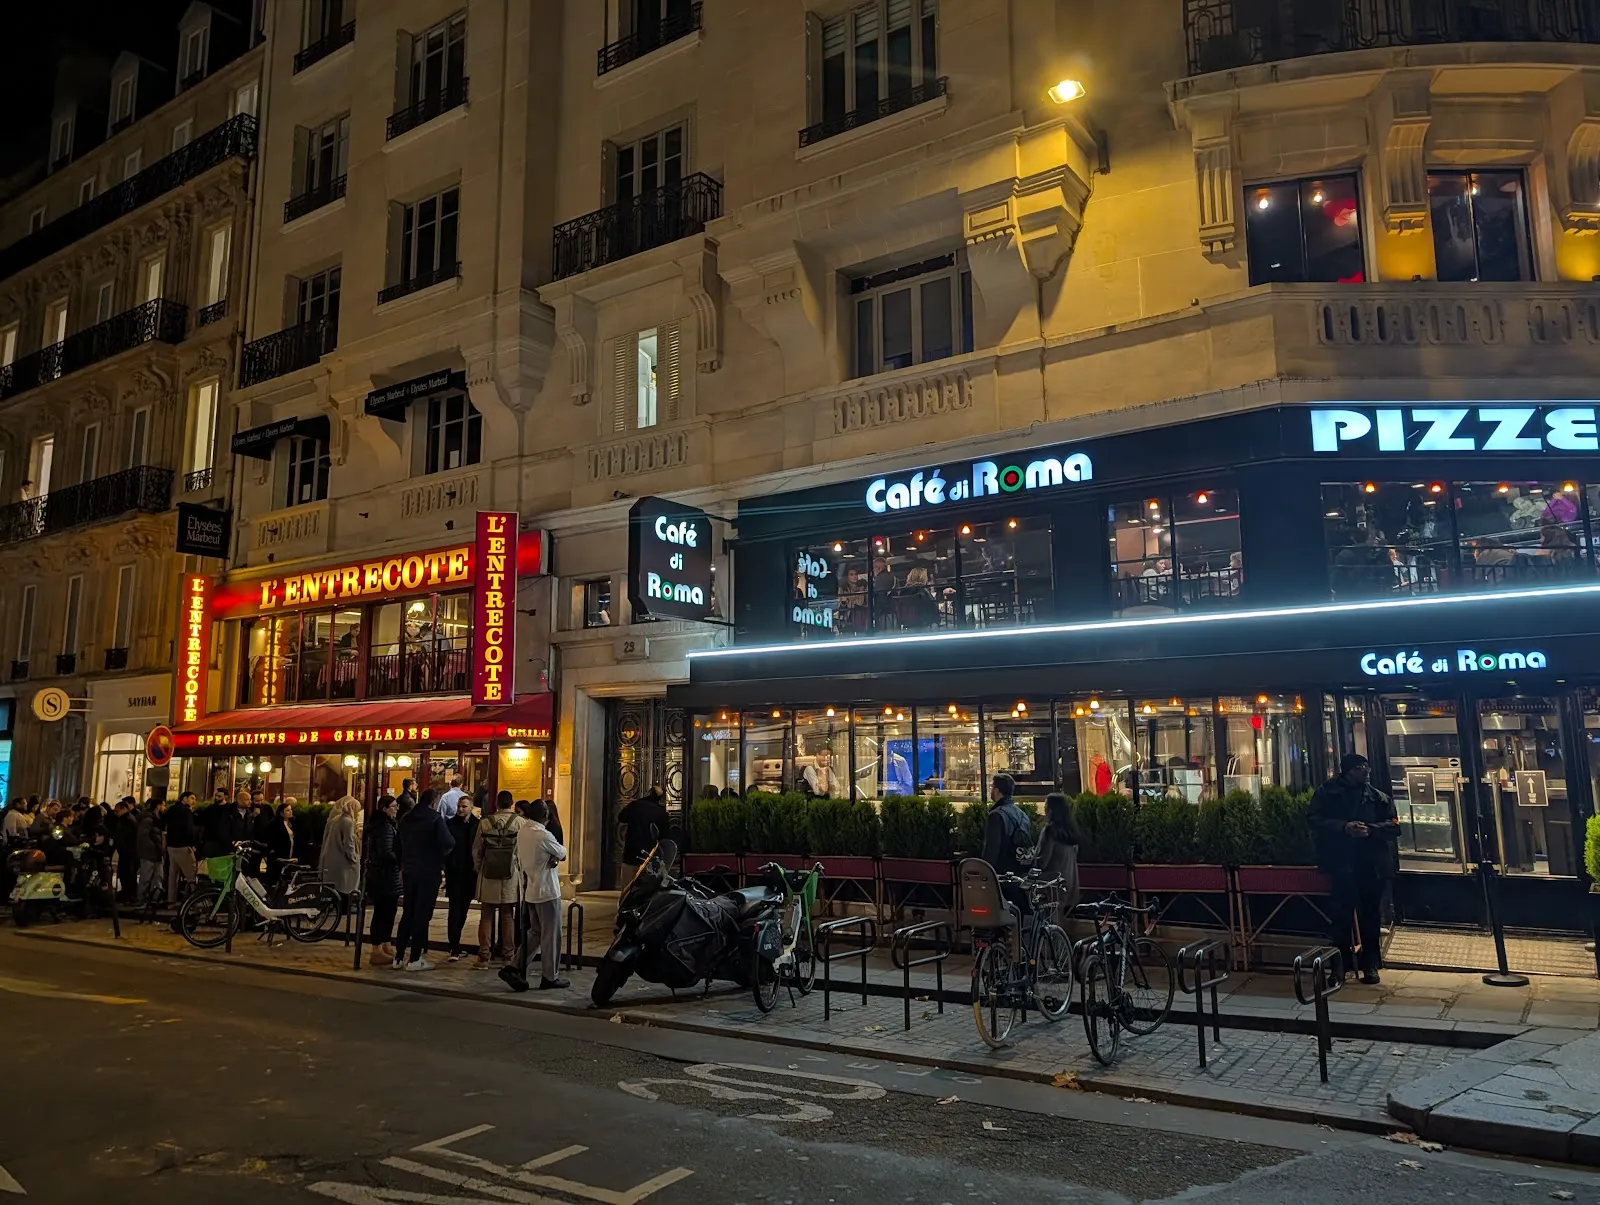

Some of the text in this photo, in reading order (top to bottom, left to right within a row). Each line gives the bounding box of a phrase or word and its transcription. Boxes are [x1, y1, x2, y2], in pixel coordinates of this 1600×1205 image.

[1310, 408, 1599, 452] PIZZE
[865, 452, 1093, 513] Café di Roma
[186, 529, 222, 545] Marbeuf
[187, 514, 222, 533] Élysées
[655, 515, 697, 547] Café
[669, 553, 683, 571] di
[647, 572, 704, 605] Roma
[483, 516, 507, 701] L'ENTRECOTE
[184, 578, 205, 722] L'ENTRECOTE
[623, 641, 635, 653] 29
[1360, 649, 1547, 676] Café di Roma
[197, 727, 431, 746] SPECIALITES DE GRILLADES
